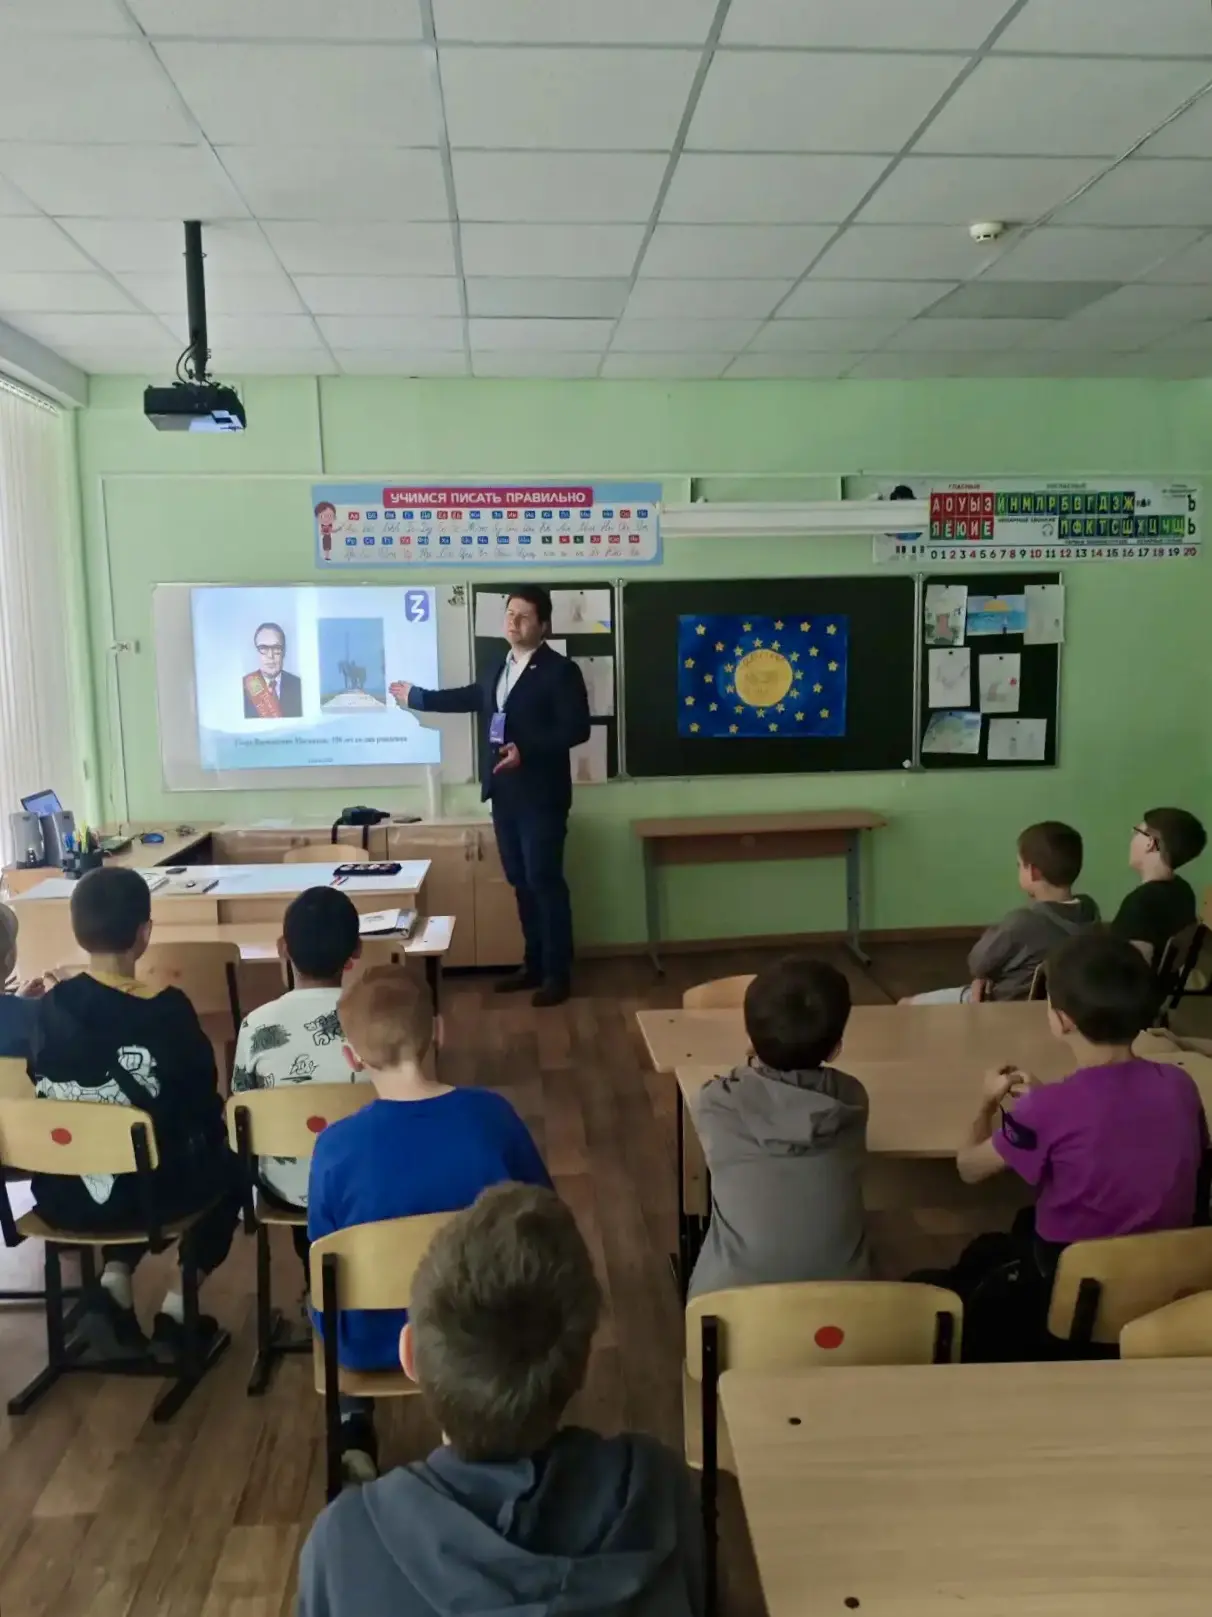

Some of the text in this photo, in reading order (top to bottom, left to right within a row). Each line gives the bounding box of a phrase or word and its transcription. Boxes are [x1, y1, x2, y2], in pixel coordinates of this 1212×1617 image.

[390, 491, 586, 503] УЧИМСЯ ПИСАТЬ ПРАВИЛЬНО
[931, 547, 1197, 559] 0 1 2 3 4 5 6 7 8 9 10 11 12 13 14 15 16 17 18 19 20
